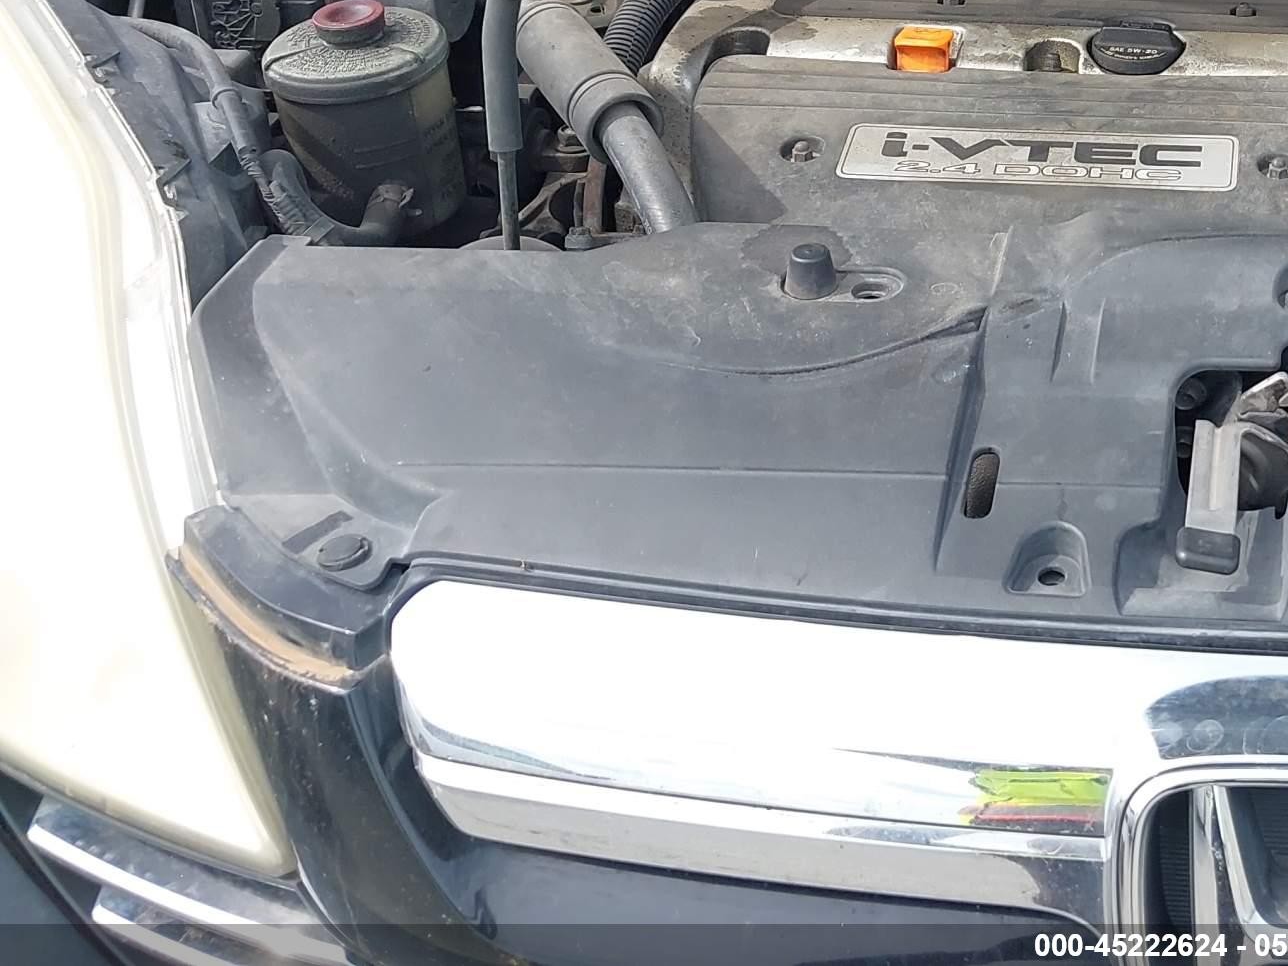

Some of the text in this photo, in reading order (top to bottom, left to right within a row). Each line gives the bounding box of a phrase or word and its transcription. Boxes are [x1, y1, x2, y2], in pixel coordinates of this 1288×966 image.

[881, 132, 1203, 167] i-VTEC
[893, 160, 1183, 181] 2.4 DOHC
